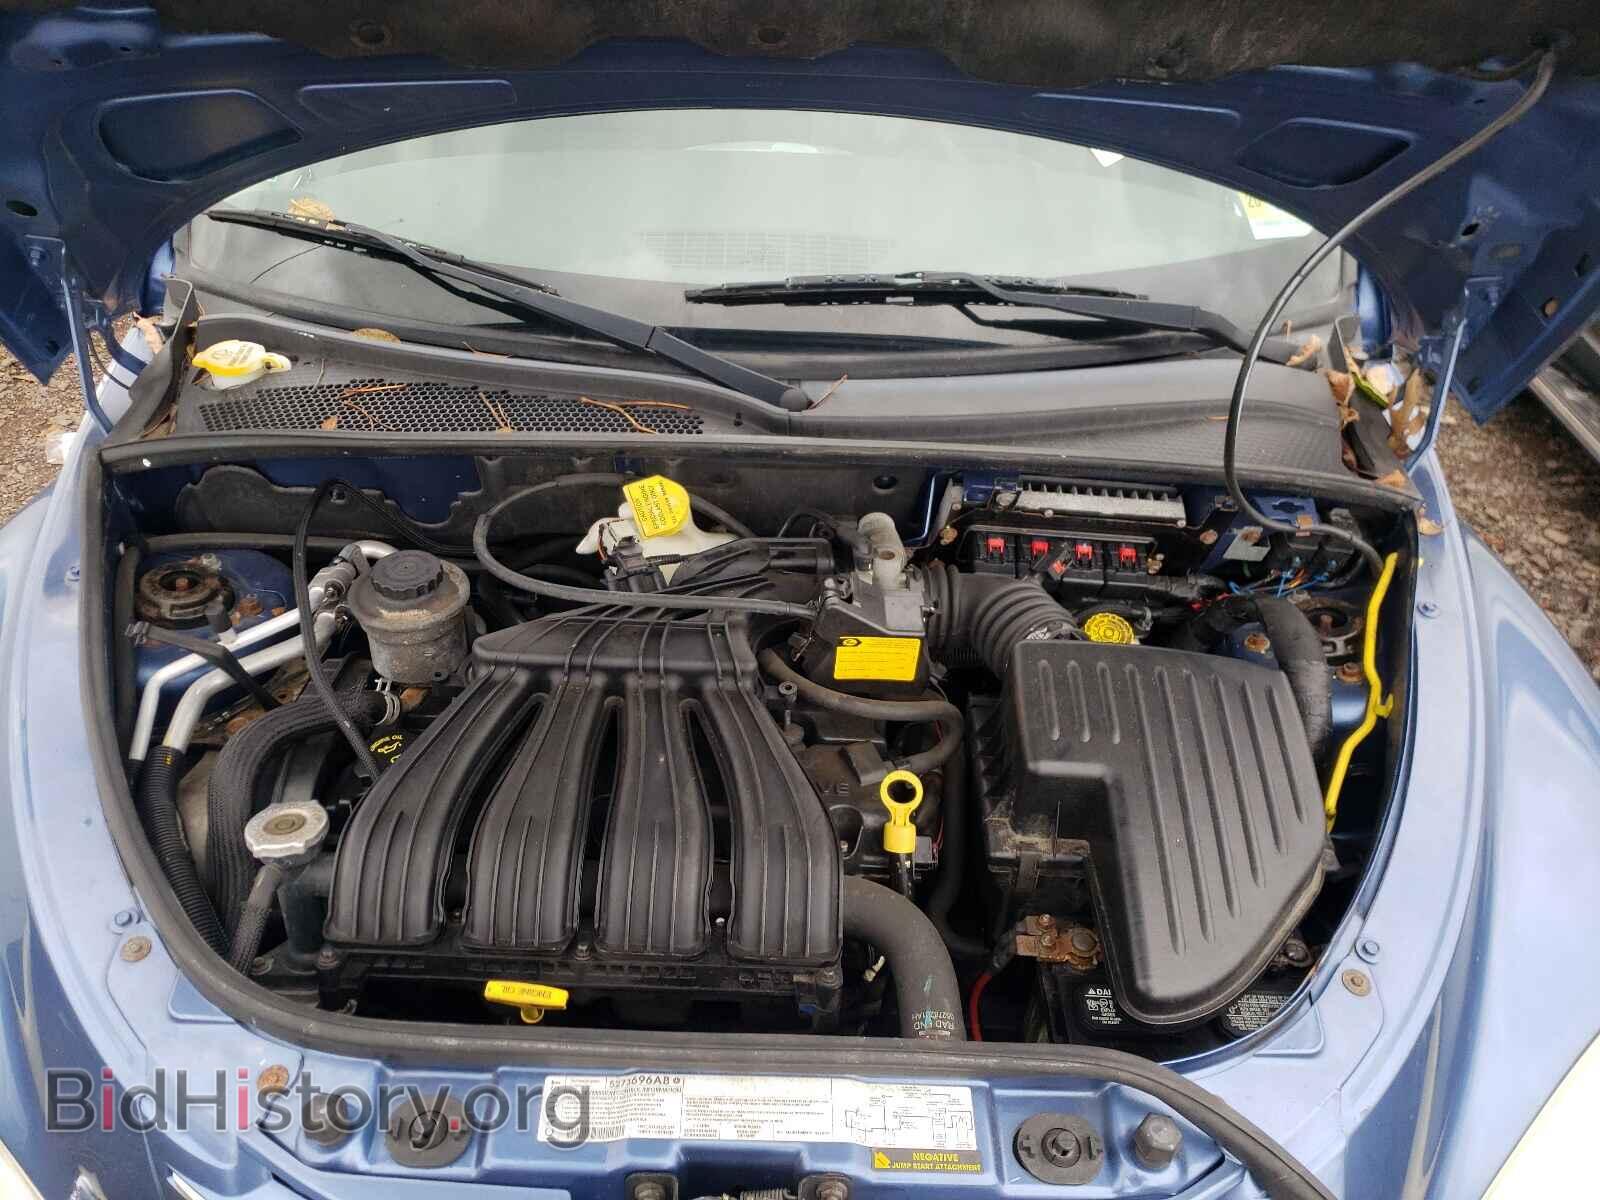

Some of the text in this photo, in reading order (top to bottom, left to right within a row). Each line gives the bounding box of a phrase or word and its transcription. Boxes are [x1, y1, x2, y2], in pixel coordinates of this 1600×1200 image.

[912, 1152, 959, 1162] NEGATIVE
[892, 1161, 981, 1173] JUMP START ATTACHMENT
